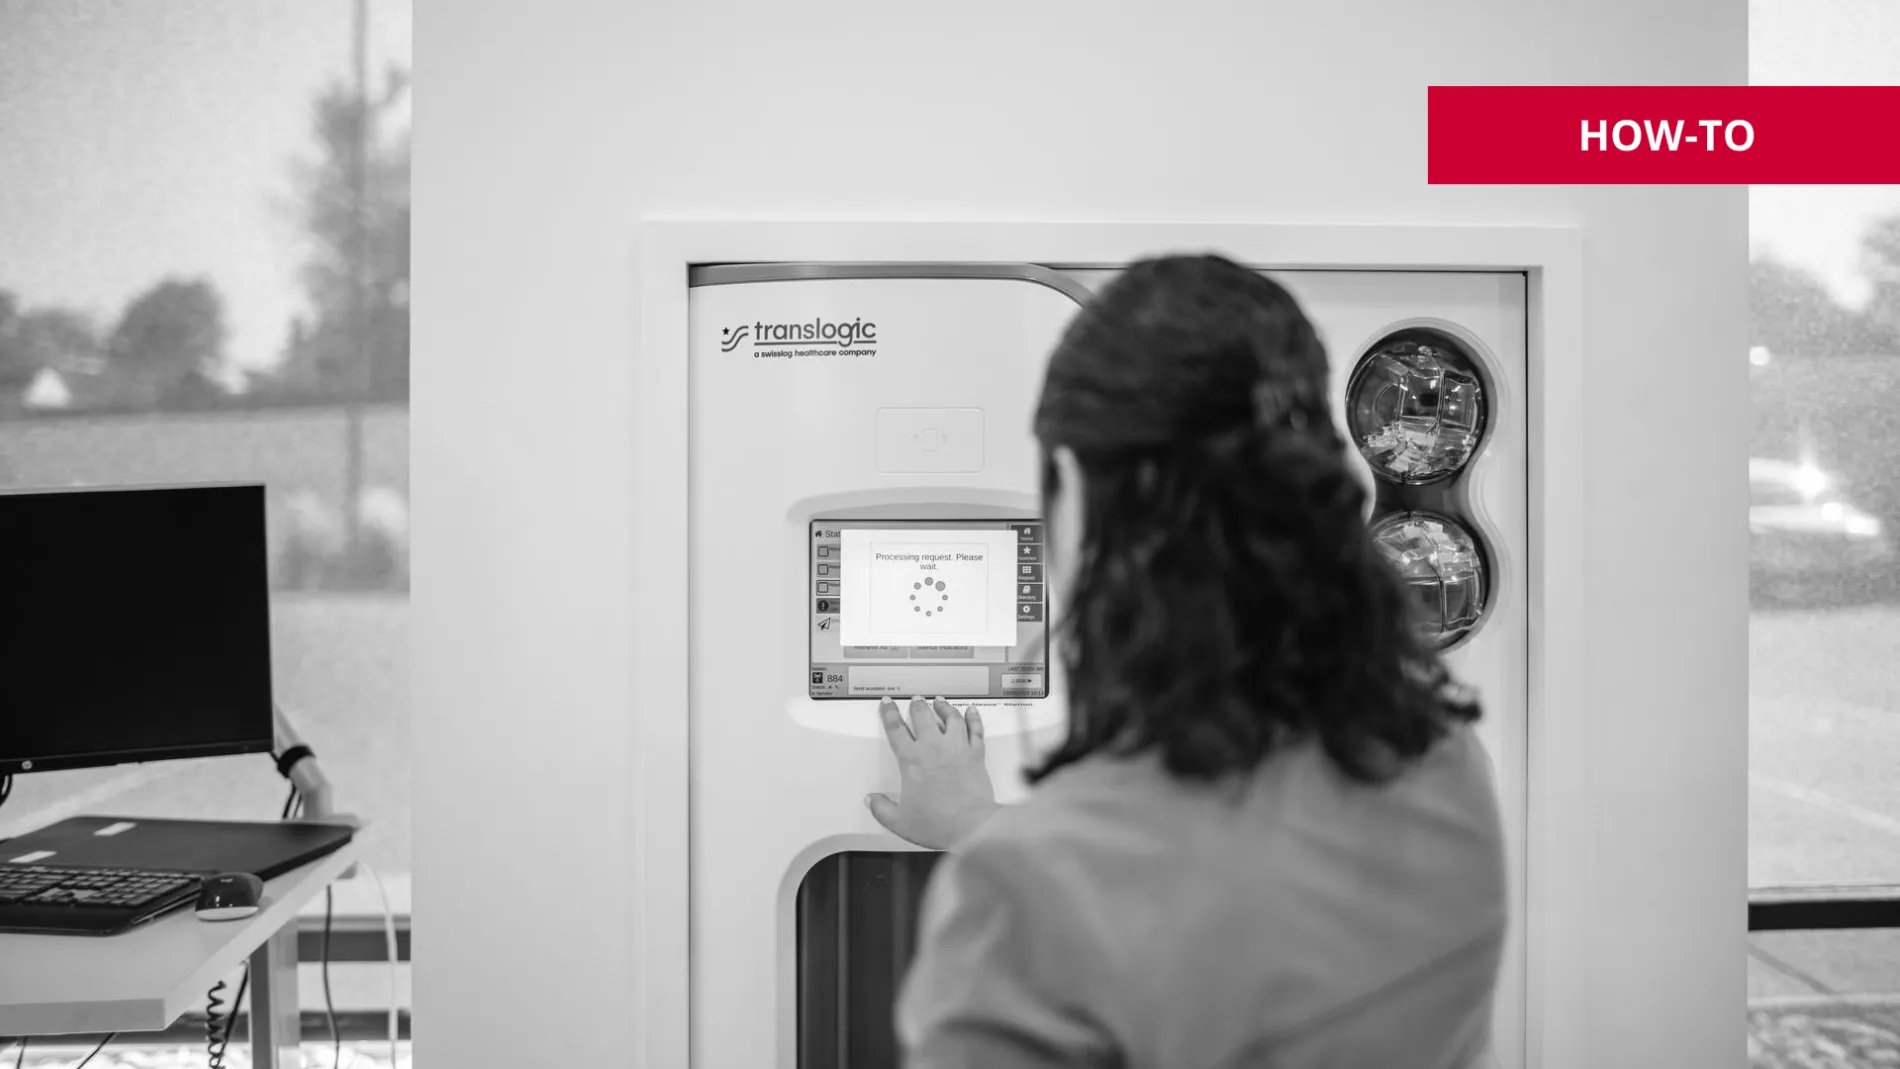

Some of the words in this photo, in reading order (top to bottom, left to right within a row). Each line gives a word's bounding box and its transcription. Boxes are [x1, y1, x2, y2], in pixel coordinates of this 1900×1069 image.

[754, 317, 877, 347] translogic
[761, 350, 793, 358] swisslog
[795, 349, 837, 357] healthcare
[838, 349, 877, 357] company
[825, 530, 840, 538] Stat
[875, 552, 920, 562] Processing
[921, 553, 952, 562] request.
[956, 552, 983, 561] Please
[827, 674, 843, 682] 884
